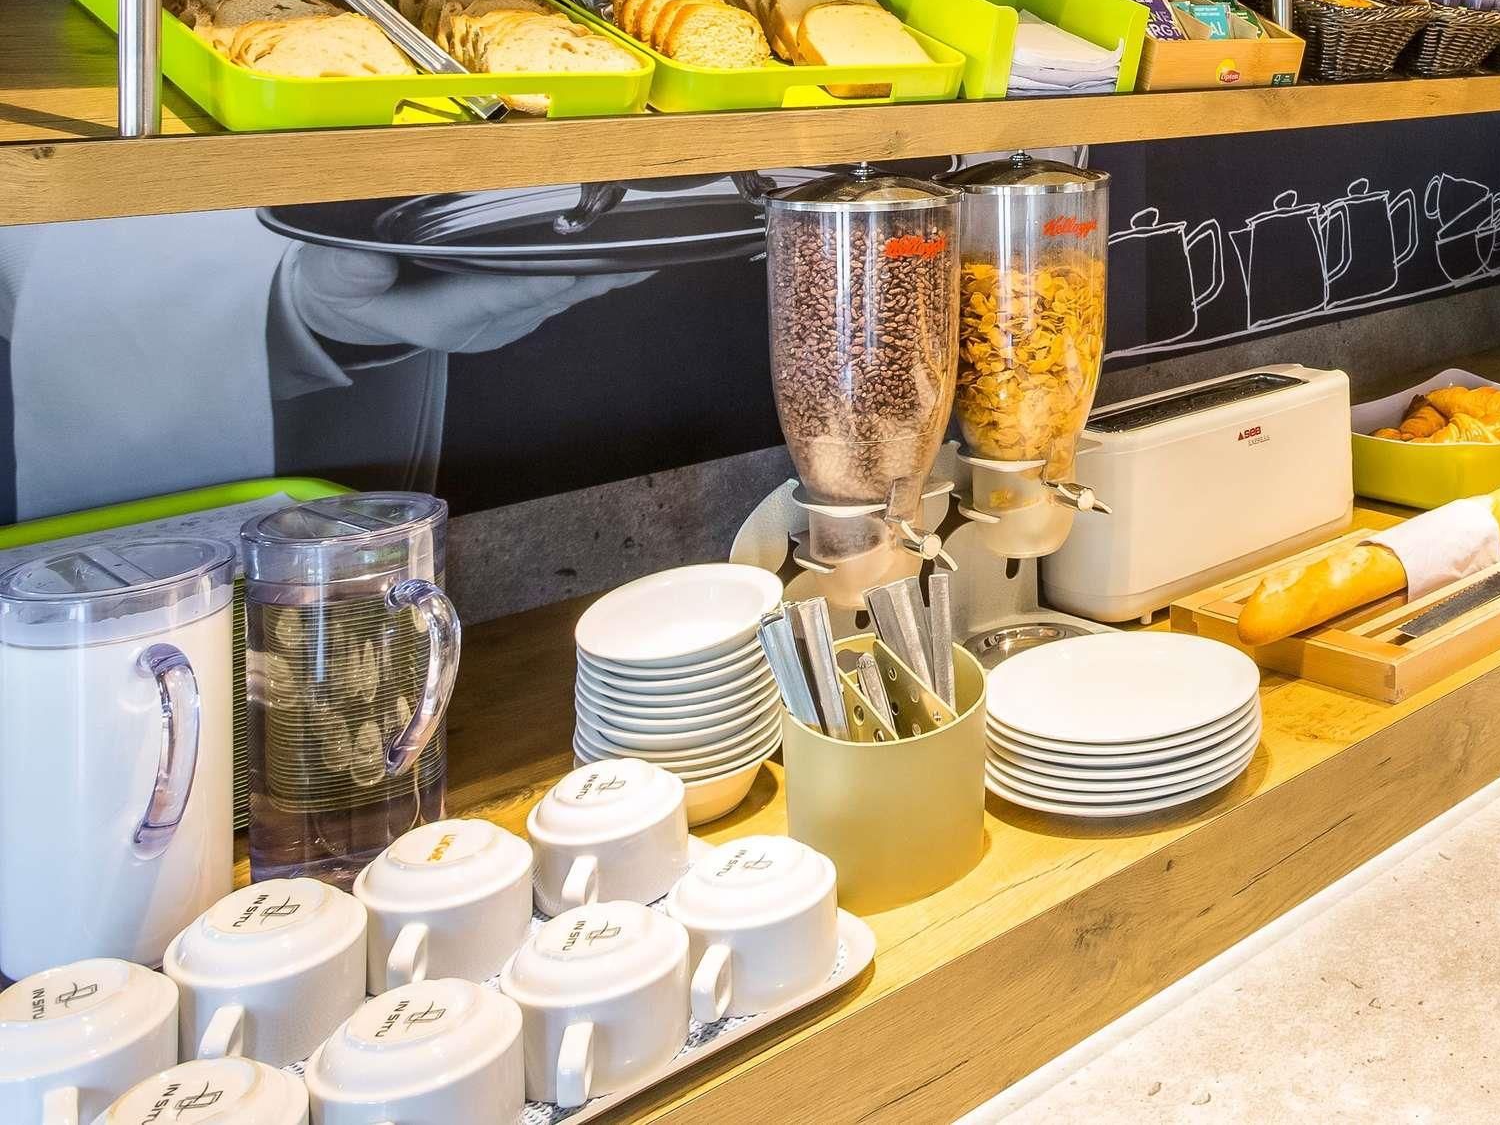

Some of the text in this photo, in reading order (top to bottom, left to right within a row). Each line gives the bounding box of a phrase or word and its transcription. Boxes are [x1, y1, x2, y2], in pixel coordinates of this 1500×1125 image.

[232, 894, 269, 927] IN SITU
[562, 920, 586, 951] IN SITU
[32, 987, 45, 1020] IN SITU
[375, 1000, 410, 1037] IN SITU
[162, 1083, 181, 1096] IN
